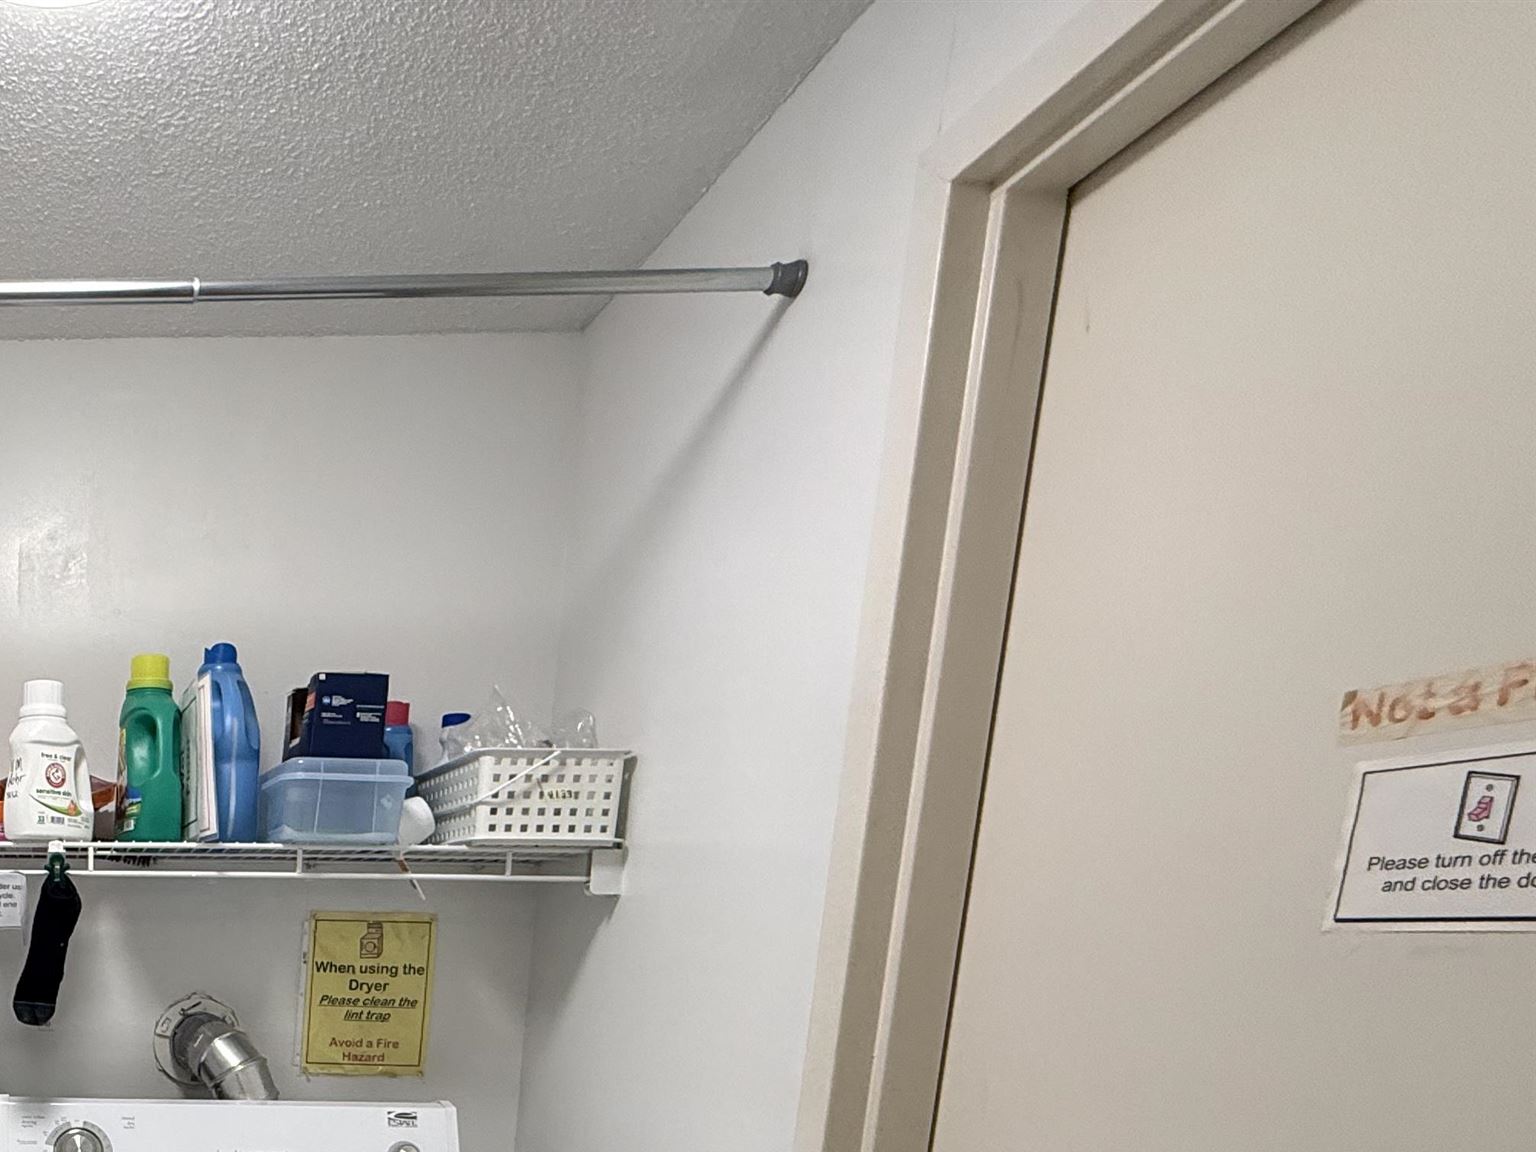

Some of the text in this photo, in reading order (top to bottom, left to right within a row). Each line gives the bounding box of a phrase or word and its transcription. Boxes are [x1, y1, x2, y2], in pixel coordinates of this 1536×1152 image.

[1366, 847, 1536, 872] Please turn off the
[1381, 876, 1415, 892] and
[1421, 875, 1472, 891] close
[1478, 873, 1511, 890] the
[314, 960, 425, 978] When using the
[348, 978, 390, 994] Dryer
[319, 994, 418, 1009] Please clean the
[343, 1009, 391, 1023] lint trap
[328, 1037, 400, 1049] Avoid a Fire
[342, 1052, 385, 1063] Hazard
